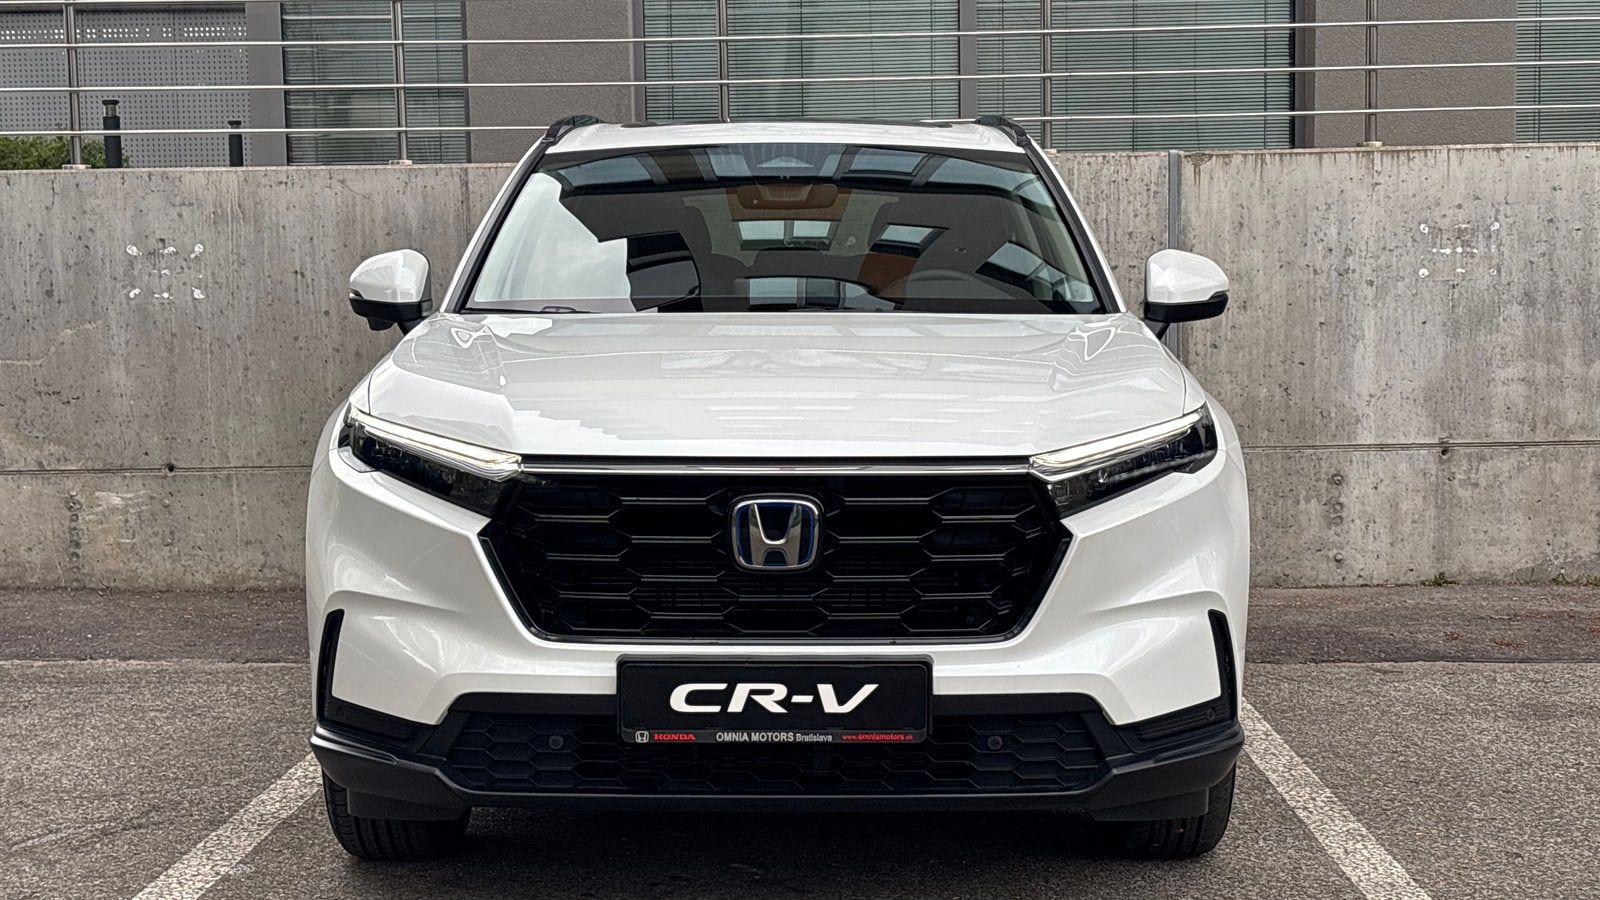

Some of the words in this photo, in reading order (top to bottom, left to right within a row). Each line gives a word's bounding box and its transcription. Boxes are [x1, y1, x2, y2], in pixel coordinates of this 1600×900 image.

[669, 683, 879, 713] CR-V
[654, 733, 696, 741] HONDA
[715, 732, 749, 742] OMNIA
[751, 732, 794, 742] MOTORS
[796, 733, 833, 742] Bratislava
[842, 733, 913, 741] www.omniamotors.sk
